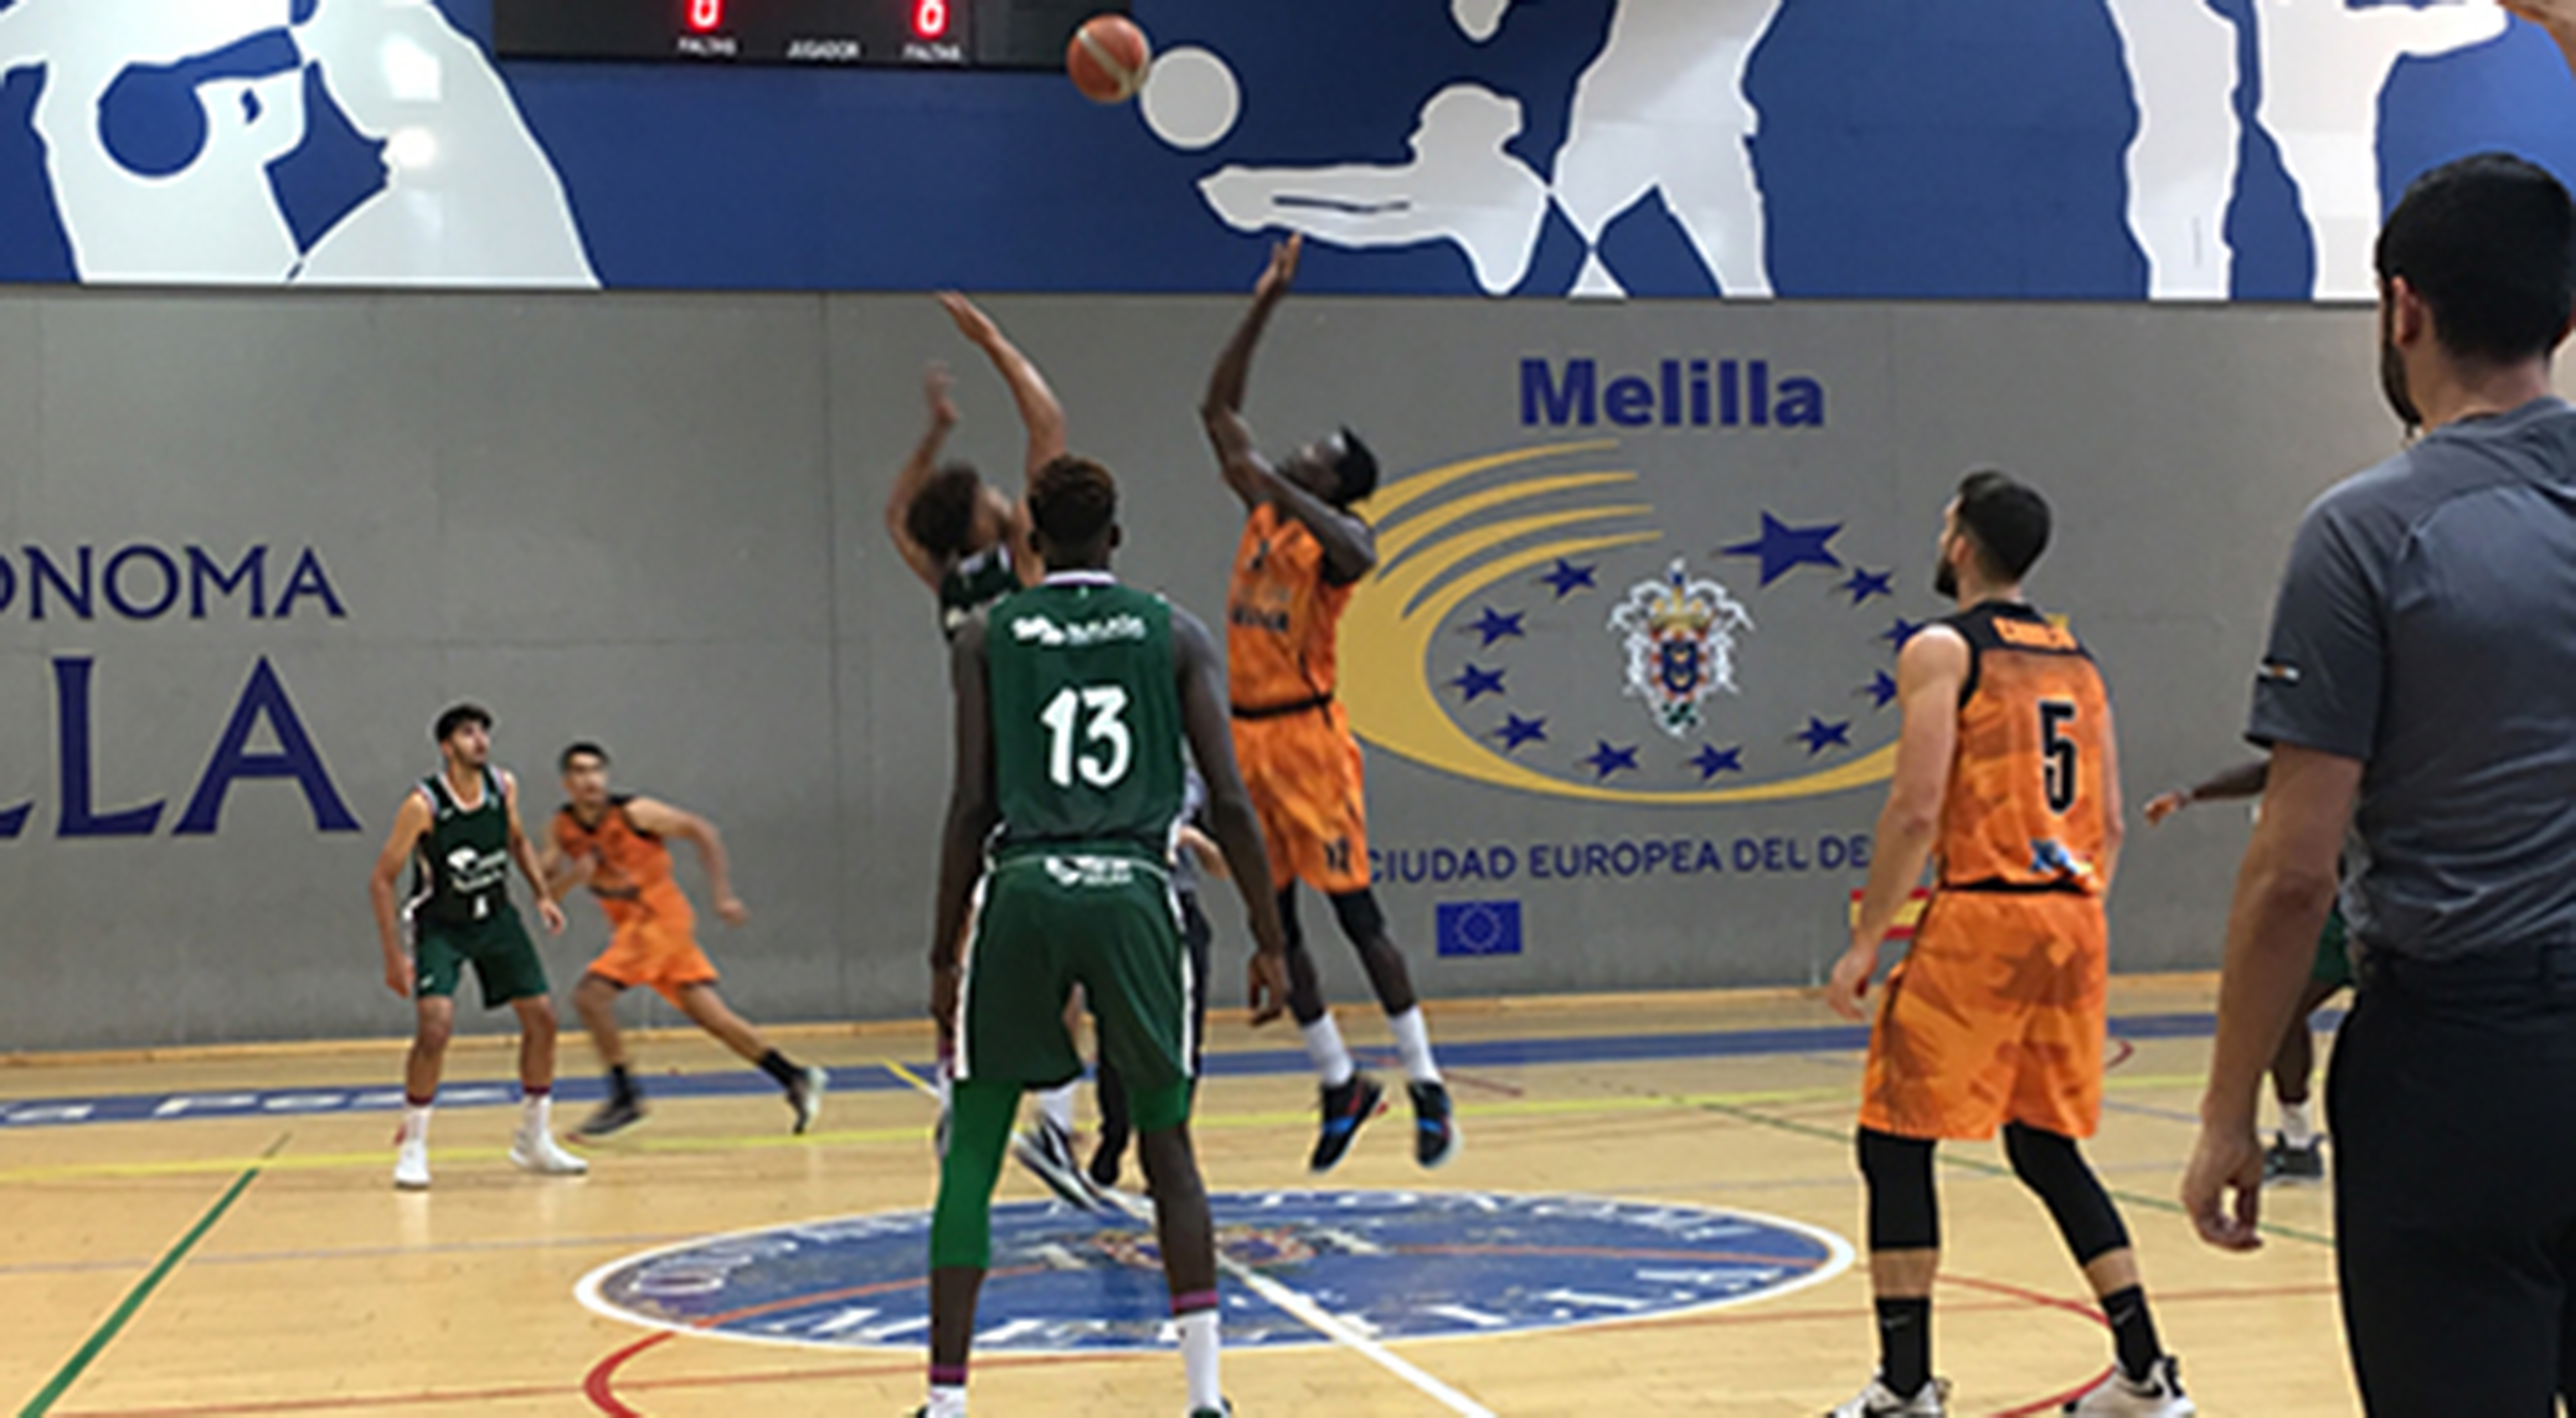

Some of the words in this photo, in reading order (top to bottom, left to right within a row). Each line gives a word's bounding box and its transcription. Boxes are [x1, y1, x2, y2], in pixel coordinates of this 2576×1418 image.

[1520, 358, 1824, 427] Melilla
[0, 545, 347, 620] NOMA
[0, 655, 363, 838] LA
[1041, 686, 1130, 787] 13
[2039, 699, 2075, 813] 5
[1528, 840, 1723, 879] EUROPEA
[1733, 837, 1809, 872] DEL
